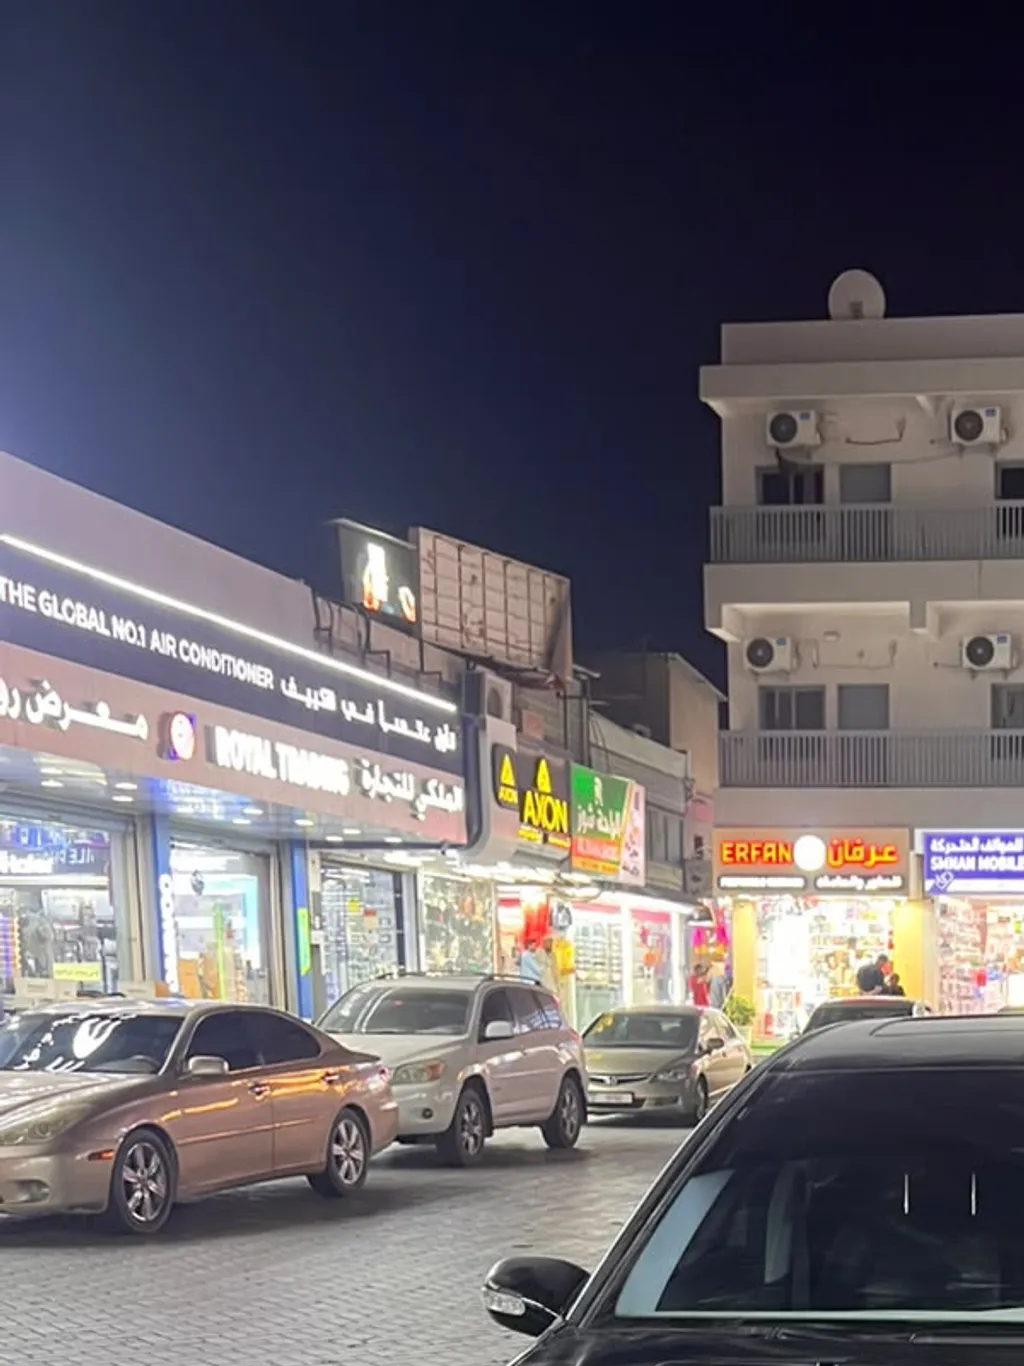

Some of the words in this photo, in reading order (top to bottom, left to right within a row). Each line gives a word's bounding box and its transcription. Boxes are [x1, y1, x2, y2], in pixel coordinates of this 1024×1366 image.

[0, 575, 37, 612] THE
[38, 589, 111, 638] GLOBAL
[111, 615, 147, 649] NO.1
[151, 629, 178, 659] AIR
[179, 639, 275, 690] CONDITIONER
[25, 680, 149, 741] معرض
[215, 726, 277, 780] ROYAL
[360, 758, 415, 803] للتجارة
[416, 778, 465, 821] الملكي
[524, 790, 569, 834] AXON
[720, 841, 794, 865] ERFAN
[827, 836, 898, 868] عرفان
